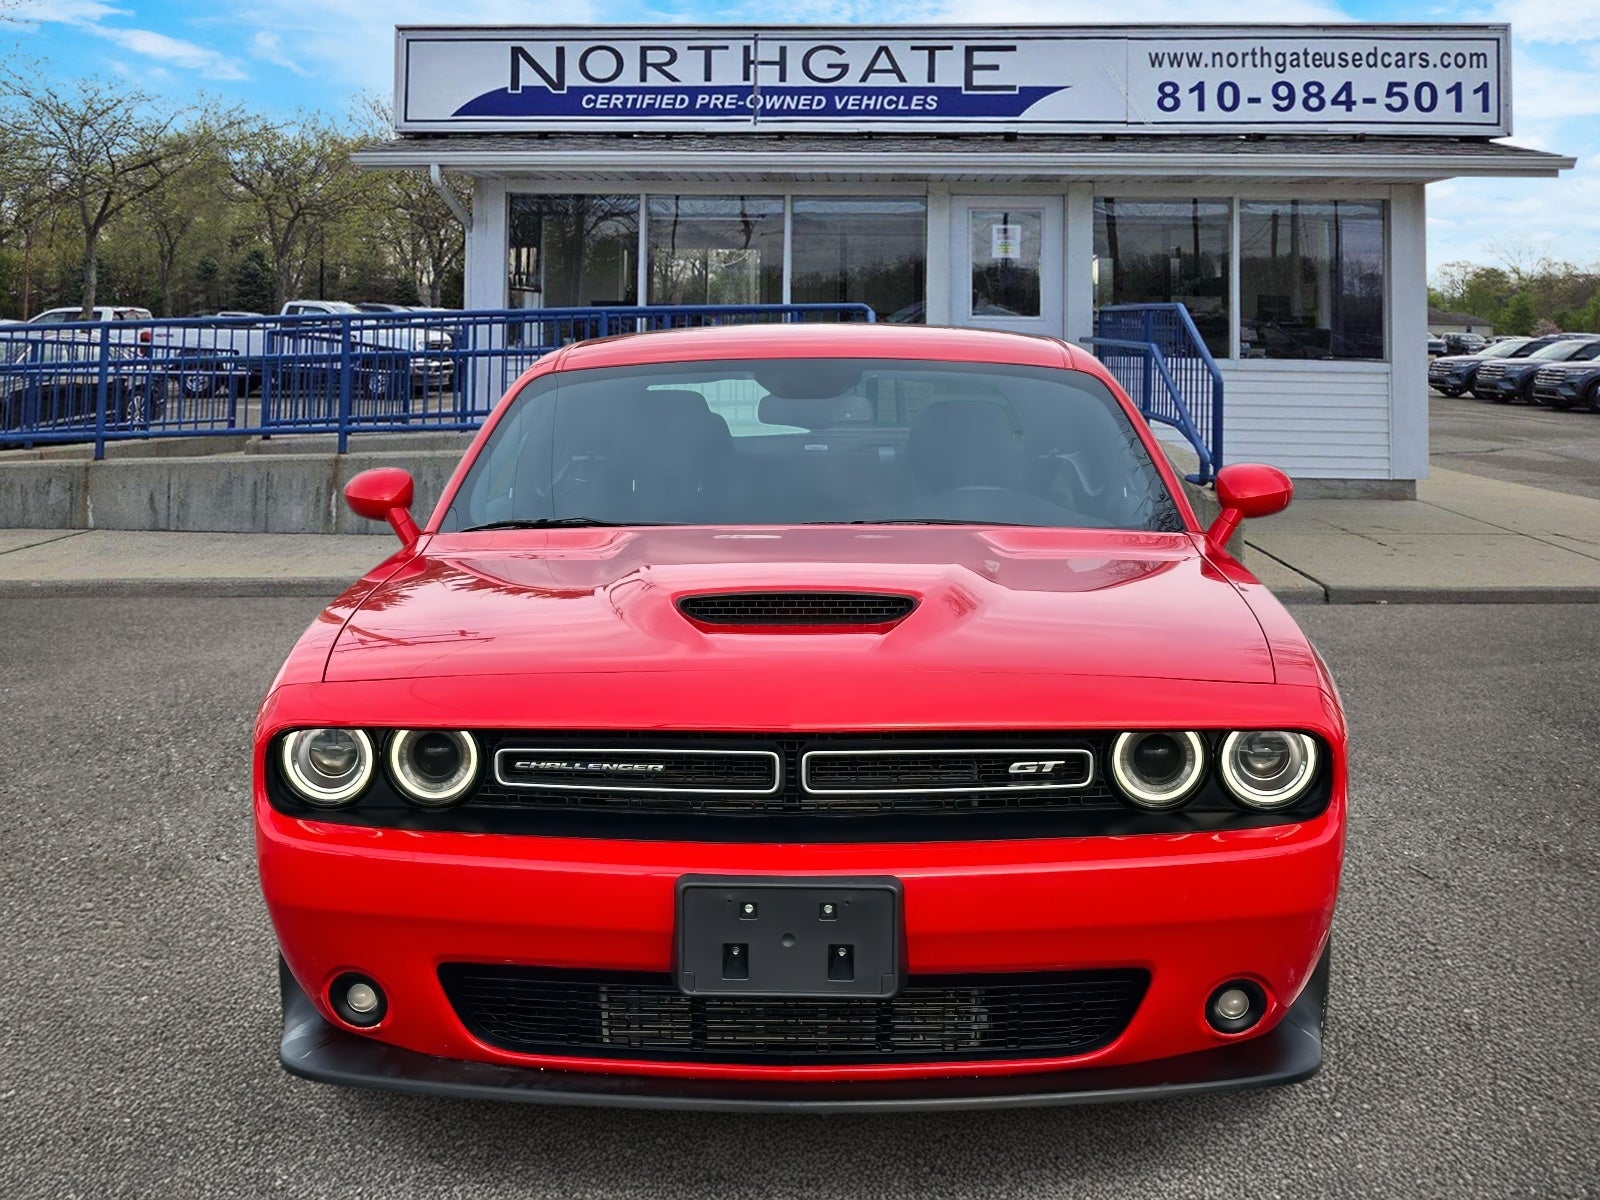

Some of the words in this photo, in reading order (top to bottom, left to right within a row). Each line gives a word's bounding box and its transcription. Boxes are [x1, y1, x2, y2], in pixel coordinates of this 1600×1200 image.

[510, 45, 1017, 92] NORTHGATE
[1148, 46, 1488, 73] www.northgateusedcars.com
[581, 93, 690, 110] CERTIFIED
[695, 94, 827, 111] PRE-OWNED
[834, 95, 939, 111] VEHICLES
[1156, 80, 1491, 113] 810-984-5011
[514, 761, 664, 772] CHALLENGER
[1008, 760, 1066, 774] GT
